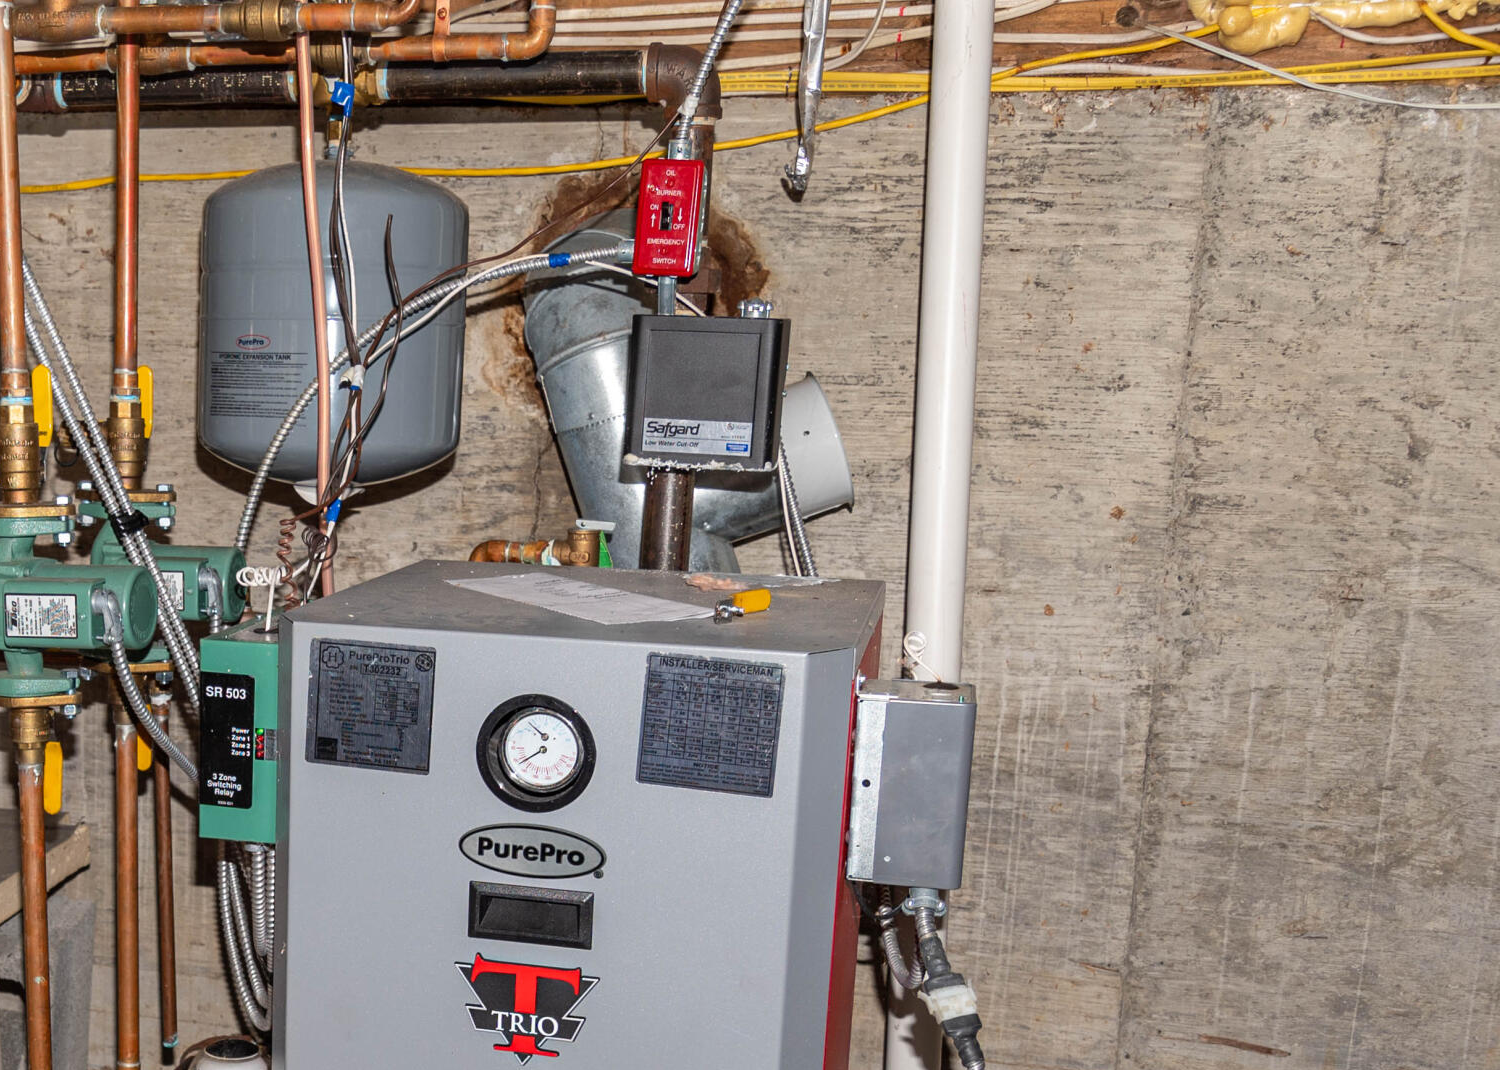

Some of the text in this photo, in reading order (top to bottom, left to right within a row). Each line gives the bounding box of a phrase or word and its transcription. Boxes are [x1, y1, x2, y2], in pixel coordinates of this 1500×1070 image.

[238, 338, 264, 346] PurePro
[646, 421, 700, 438] Safgard
[660, 657, 774, 677] INSTALLER/SERVICEMAN
[206, 686, 247, 700] SR 503
[232, 734, 246, 742] Zone
[246, 750, 250, 758] 3
[218, 774, 236, 782] Zone
[207, 780, 242, 791] Switching
[214, 788, 234, 798] Relay
[478, 836, 585, 866] PurePro
[491, 1010, 559, 1037] TRIO
